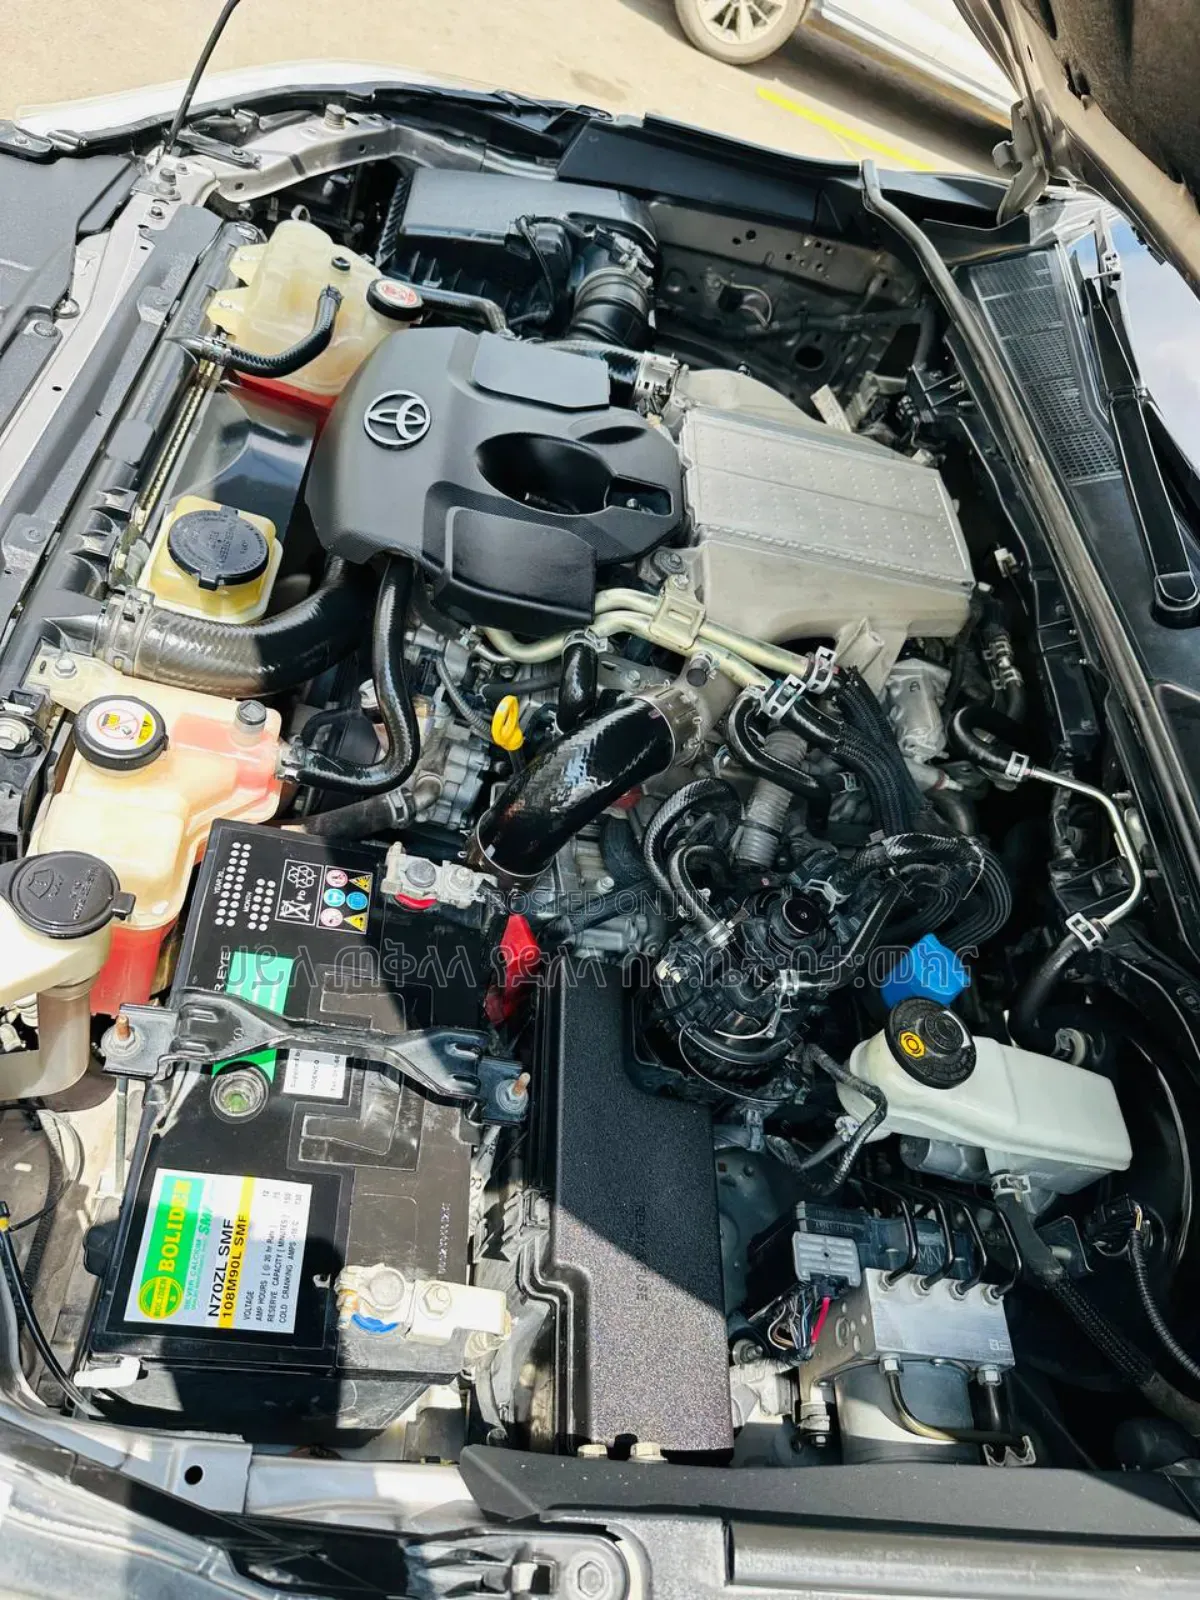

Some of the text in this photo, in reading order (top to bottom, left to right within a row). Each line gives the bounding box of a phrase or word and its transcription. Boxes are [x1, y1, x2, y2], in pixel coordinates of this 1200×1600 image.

[243, 891, 252, 912] MONTH
[217, 951, 230, 978] EYE
[287, 1242, 297, 1260] AMPS
[208, 1218, 234, 1317] N70ZL SMF
[222, 1215, 247, 1318] 108M90L SMF
[272, 1254, 283, 1286] CAPACITY
[258, 1280, 268, 1304] HOURS
[282, 1264, 293, 1299] CRANKING
[243, 1290, 255, 1320] VOLTAGE
[255, 1306, 264, 1321] AMP
[267, 1291, 278, 1322] RESERVE
[278, 1304, 288, 1323] COLD
